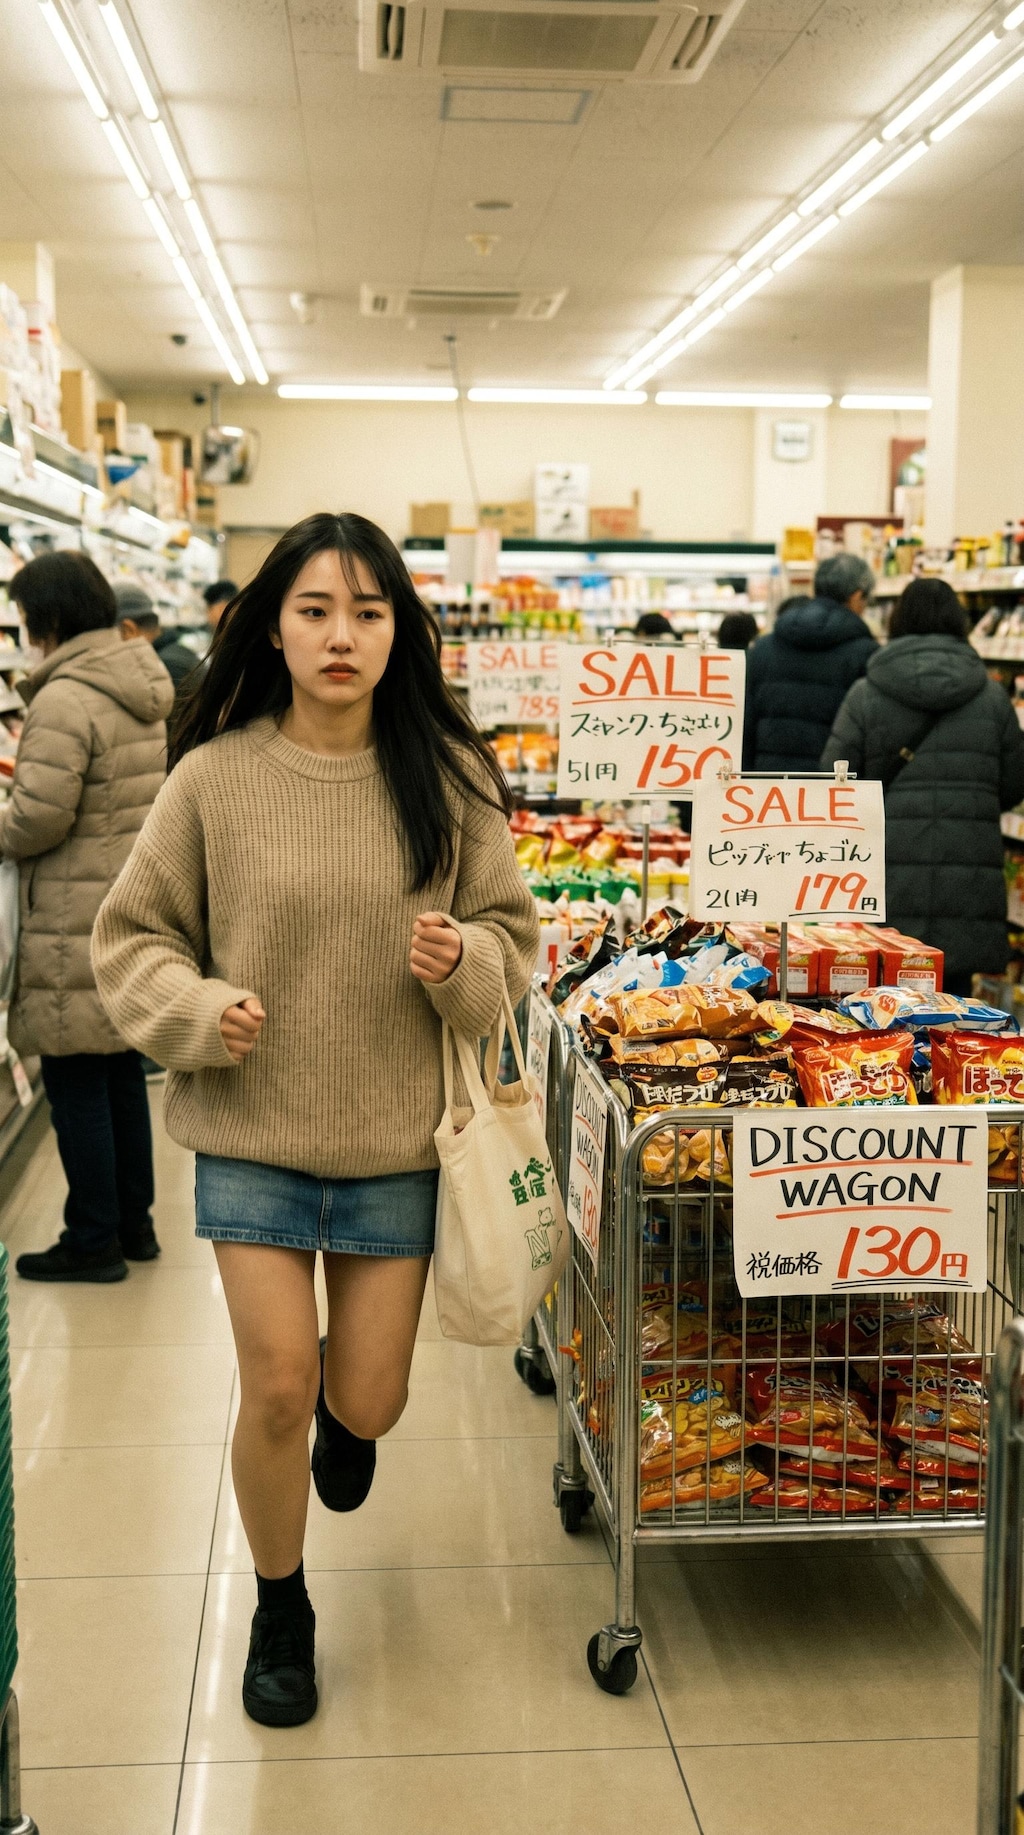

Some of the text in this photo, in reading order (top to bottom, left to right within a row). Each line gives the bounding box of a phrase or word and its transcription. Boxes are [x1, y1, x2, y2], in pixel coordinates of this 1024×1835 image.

[479, 643, 559, 671] SALE
[578, 651, 733, 699] SALE
[721, 785, 859, 825] SALE
[576, 1127, 599, 1185] WAGON
[750, 1125, 977, 1167] DISCOUNT
[780, 1171, 941, 1208] WAGON
